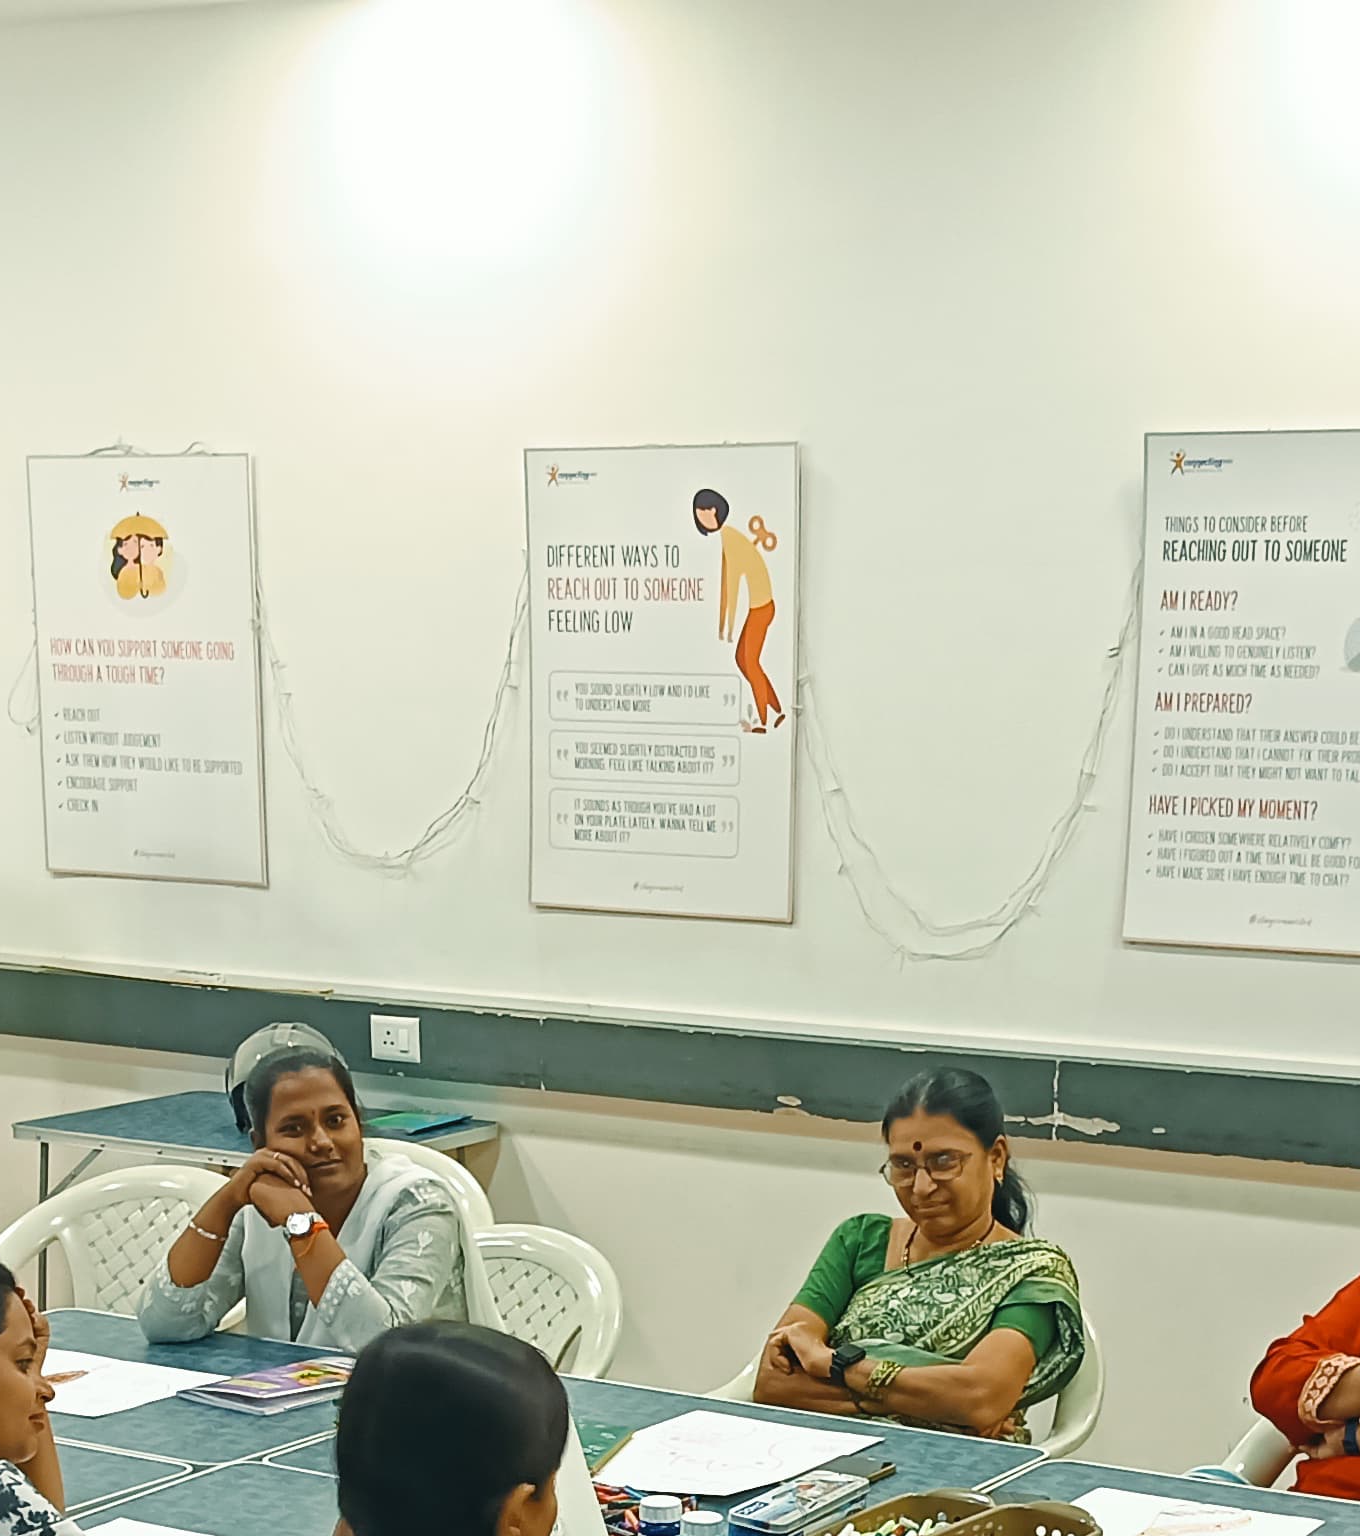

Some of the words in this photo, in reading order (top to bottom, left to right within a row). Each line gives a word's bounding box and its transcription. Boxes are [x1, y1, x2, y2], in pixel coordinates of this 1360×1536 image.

[1165, 516, 1198, 533] THINGS
[1203, 516, 1215, 532] TO
[1219, 516, 1267, 533] CONSIDER
[1270, 515, 1308, 533] BEFORE
[547, 545, 616, 568] DIFFERENT
[622, 545, 659, 568] WAYS
[665, 545, 679, 568] TO
[1163, 540, 1227, 562] REACHING
[1232, 540, 1258, 561] OUT
[1264, 540, 1280, 561] TO
[1285, 540, 1348, 562] SOMEONE
[548, 578, 589, 601] REACH
[594, 578, 617, 601] OUT
[624, 578, 639, 601] TO
[644, 578, 704, 601] SOMEONE
[1160, 589, 1179, 610] AM
[1182, 591, 1186, 610] I
[1190, 590, 1238, 611] READY?
[548, 610, 600, 633] FEELING
[605, 610, 633, 633] LOW
[1171, 626, 1183, 638] AM
[1185, 627, 1188, 638] I
[1190, 626, 1198, 638] IN
[1200, 627, 1205, 638] A
[1208, 626, 1230, 639] GOOD
[1232, 627, 1253, 640] HEAD
[1256, 627, 1286, 640] SPACE?
[50, 638, 72, 656] HOW
[75, 639, 94, 657] CAN
[97, 640, 115, 656] YOU
[118, 640, 157, 658] SUPPORT
[161, 641, 203, 660] SOMEONE
[207, 642, 235, 661] GOING
[52, 664, 93, 682] THROUGH
[96, 666, 102, 681] A
[105, 665, 135, 684] TOUGH
[139, 666, 165, 685] TIME?
[1154, 692, 1173, 711] AM
[1177, 693, 1180, 712] I
[1184, 692, 1252, 713] PREPARED?
[575, 799, 580, 809] IT
[583, 799, 610, 811] SOUNDS
[612, 800, 621, 812] AS
[624, 800, 651, 813] THOUGH
[679, 804, 694, 816] HAD
[696, 804, 700, 815] A
[703, 804, 716, 816] LOT
[1149, 795, 1179, 815] HAVE
[1183, 797, 1187, 815] I
[1190, 797, 1233, 817] PICKED
[1238, 798, 1255, 817] MY
[1259, 798, 1318, 821] MOMENT?
[575, 814, 583, 825] ON
[586, 814, 602, 826] YOUR
[605, 816, 625, 828] PLATE
[660, 819, 686, 830] WANNA
[689, 819, 704, 832] TELL
[707, 820, 716, 832] ME
[574, 829, 592, 841] MORE
[595, 831, 617, 842] ABOUT
[619, 831, 630, 843] IT?
